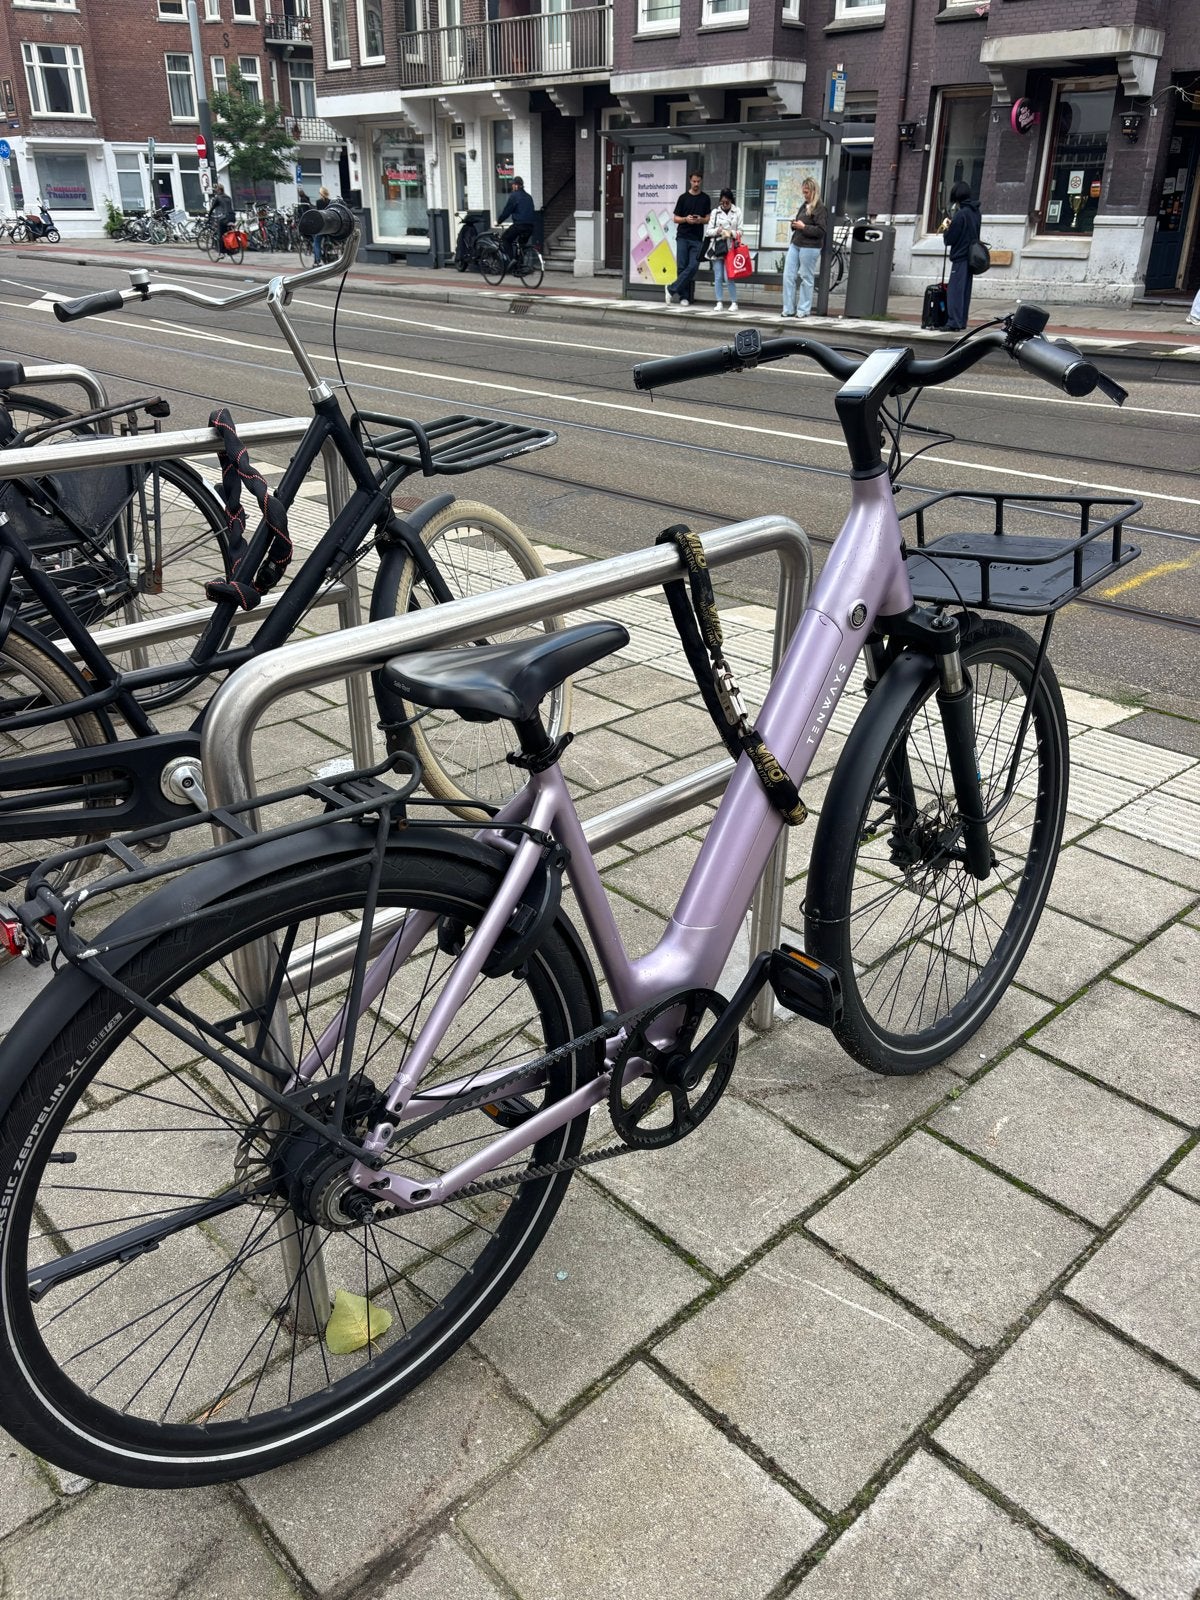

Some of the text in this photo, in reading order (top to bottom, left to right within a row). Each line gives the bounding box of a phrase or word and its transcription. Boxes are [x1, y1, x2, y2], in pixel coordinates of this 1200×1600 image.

[806, 663, 847, 745] TENWAYS
[13, 1083, 65, 1171] ZEPPELIN
[65, 1056, 87, 1079] XL
